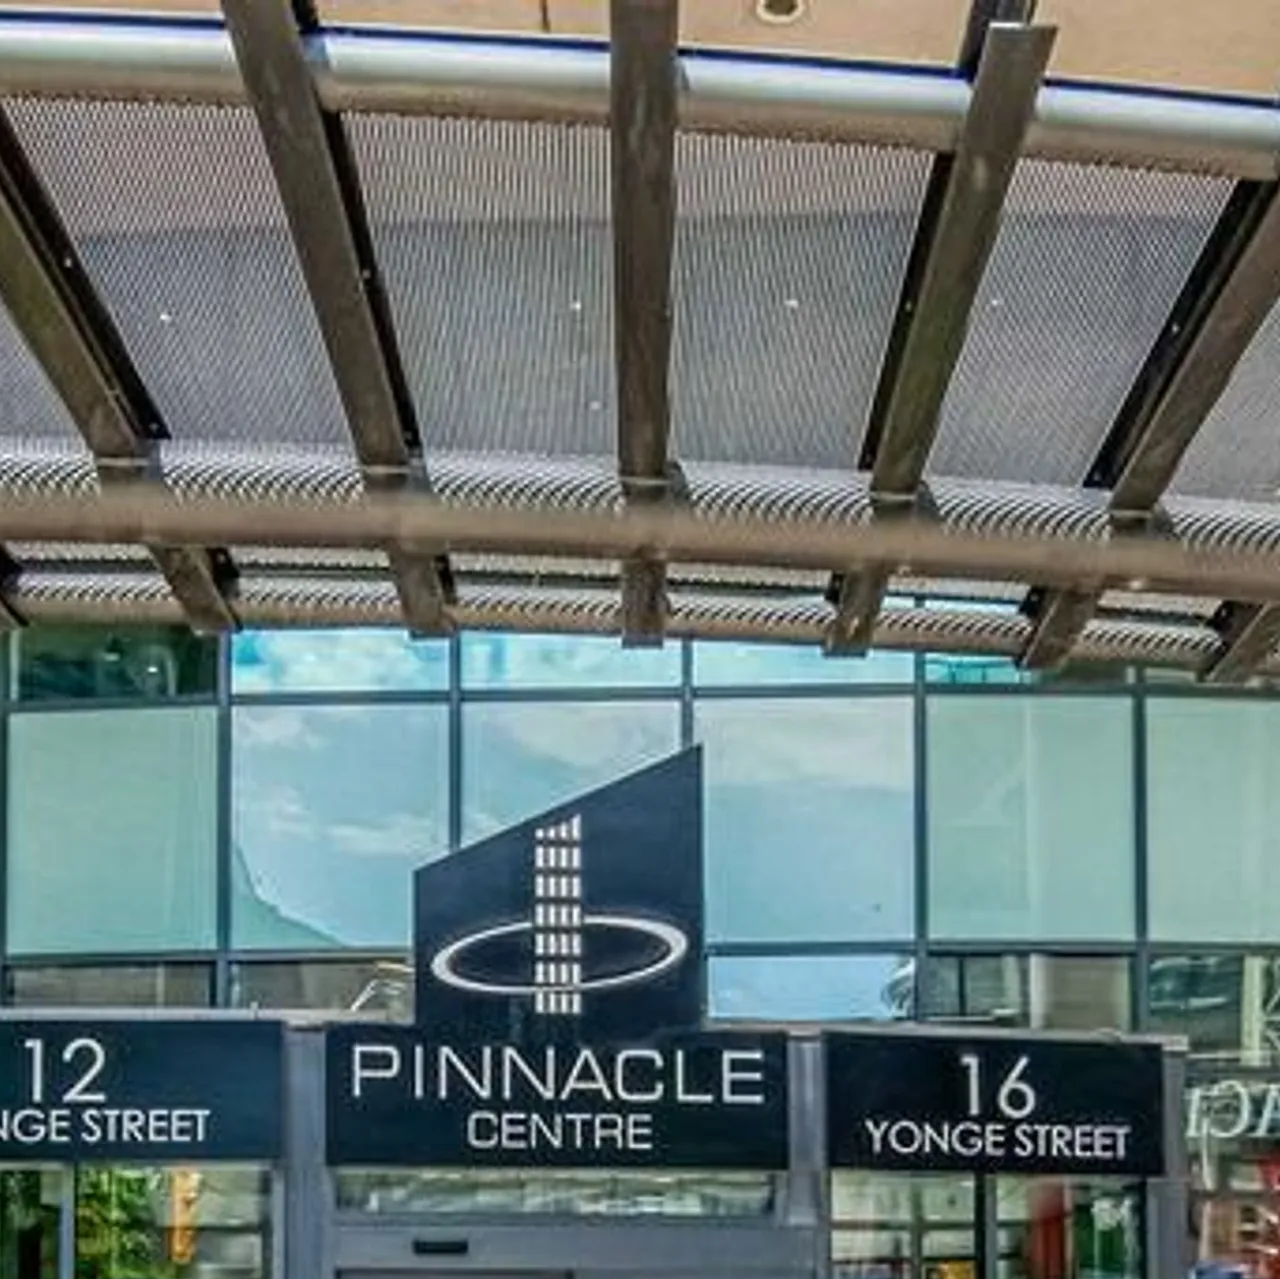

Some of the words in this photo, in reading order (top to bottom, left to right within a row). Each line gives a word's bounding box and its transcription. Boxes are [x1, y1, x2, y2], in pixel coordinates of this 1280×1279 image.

[23, 1038, 107, 1104] 12
[351, 1043, 766, 1104] PINNACLE
[960, 1052, 1037, 1119] 16
[80, 1107, 212, 1144] STREET
[466, 1110, 654, 1150] CENTRE
[864, 1119, 1006, 1157] YONGE
[1013, 1123, 1132, 1160] STREET
